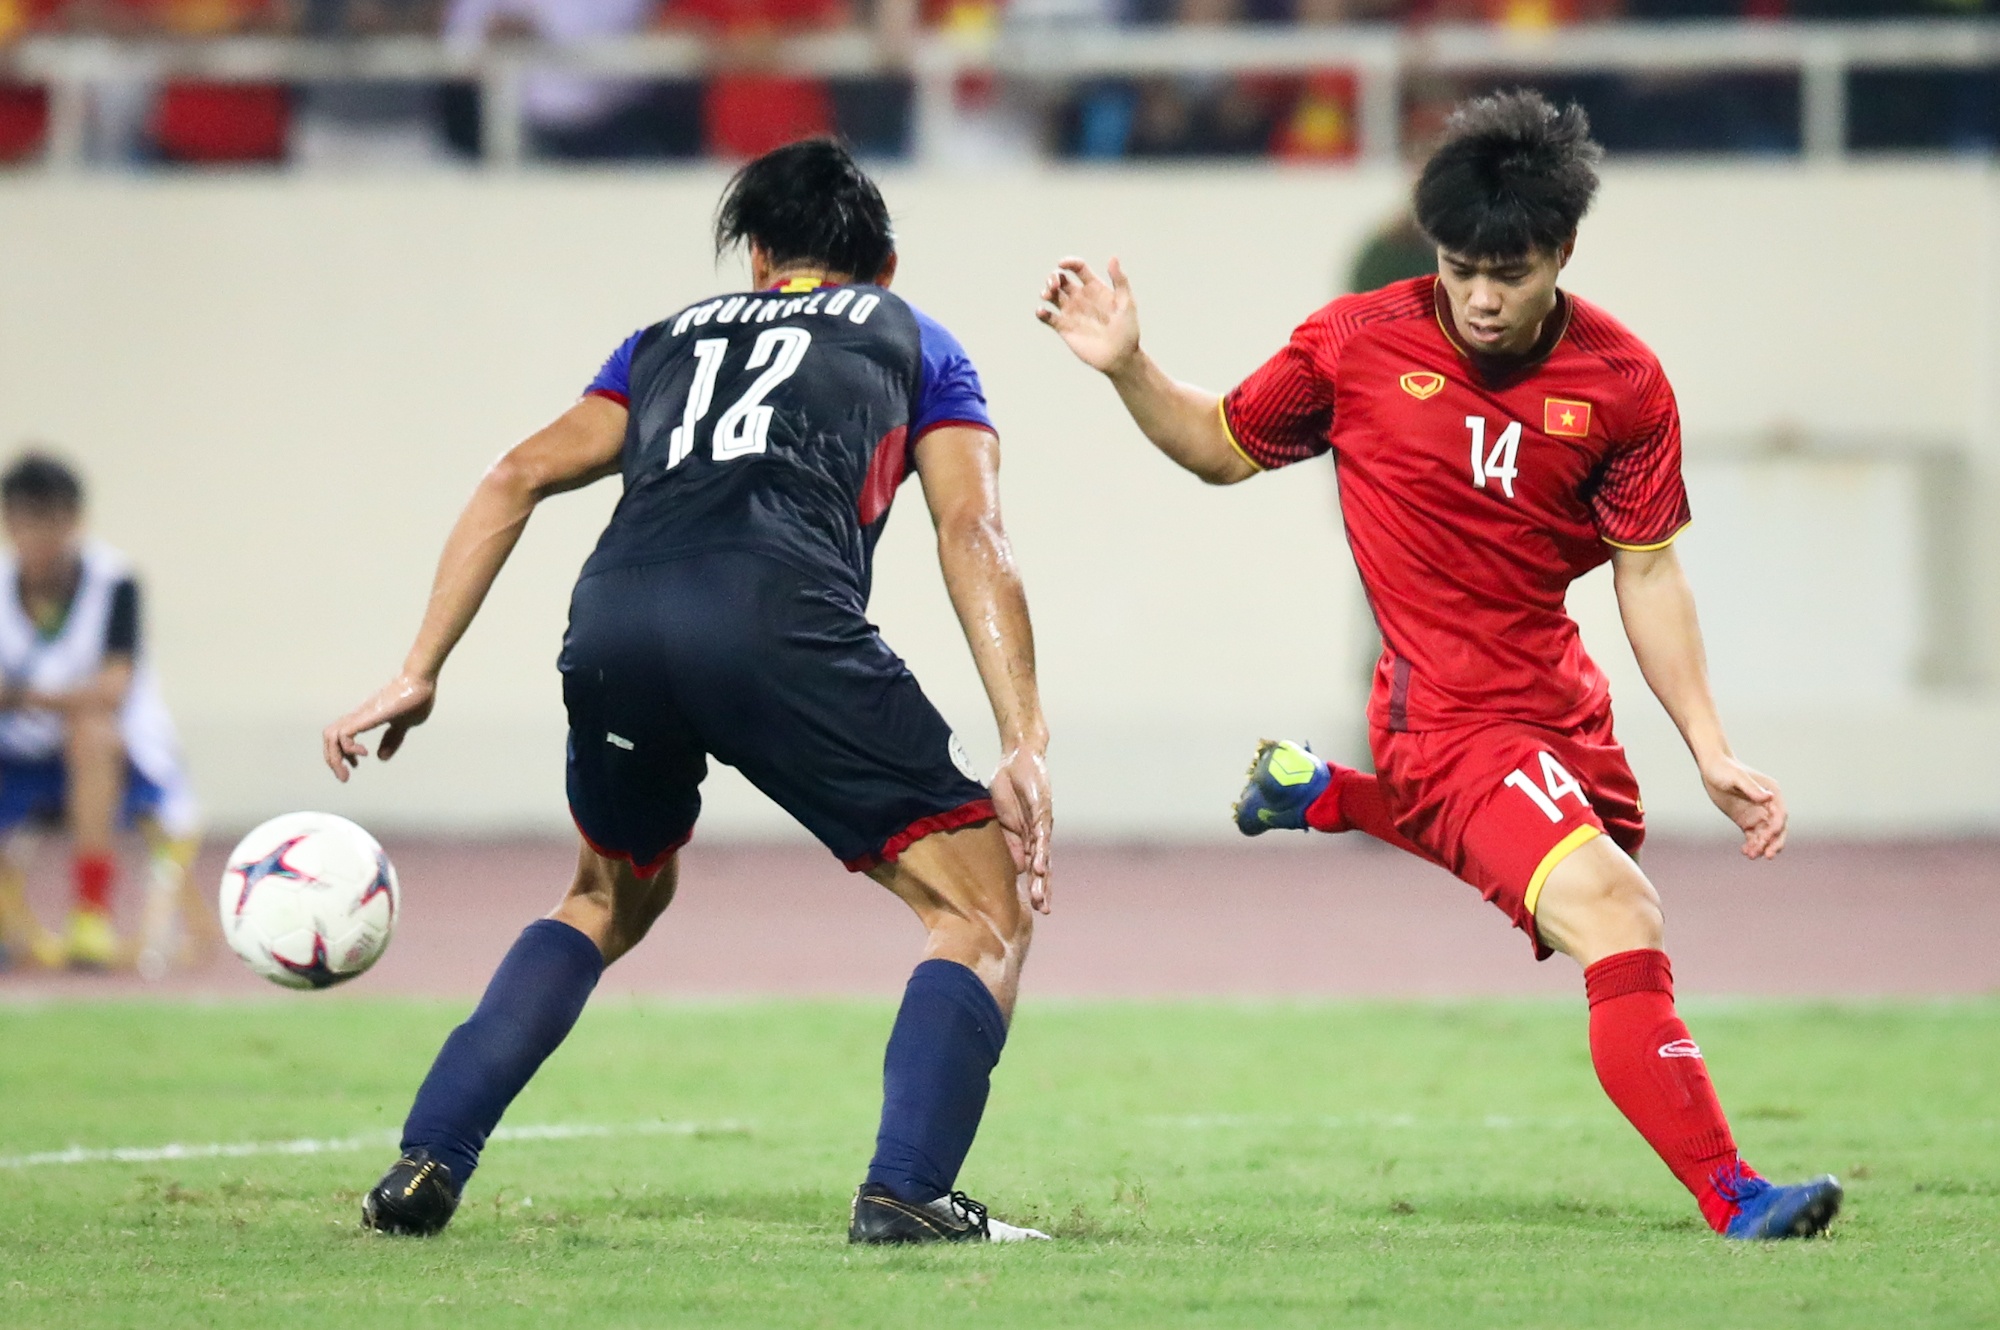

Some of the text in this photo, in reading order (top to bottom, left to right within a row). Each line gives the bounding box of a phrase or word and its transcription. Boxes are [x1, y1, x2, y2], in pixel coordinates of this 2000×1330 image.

[666, 326, 812, 471] 12
[1464, 415, 1522, 498] 14
[1503, 750, 1590, 824] 14
